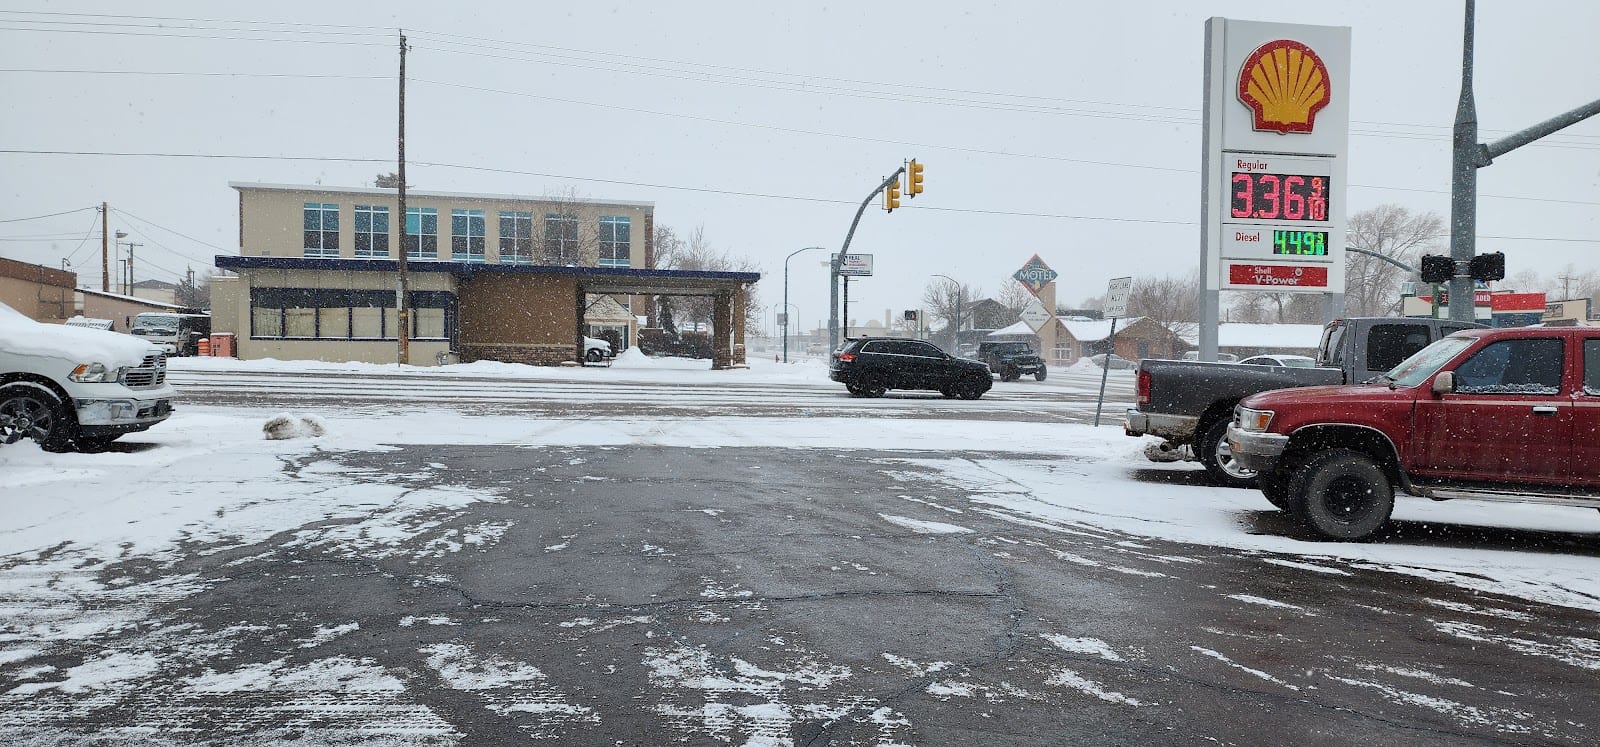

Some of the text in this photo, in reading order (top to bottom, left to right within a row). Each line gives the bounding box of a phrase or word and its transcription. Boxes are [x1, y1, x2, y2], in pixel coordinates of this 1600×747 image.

[1237, 160, 1268, 171] Regular
[1232, 173, 1305, 219] 3.36
[1236, 232, 1260, 242] Diesel
[1275, 230, 1315, 255] 4.49
[1254, 265, 1272, 274] Shell
[1019, 270, 1054, 281] MOTEL
[1255, 275, 1299, 285] V-Power
